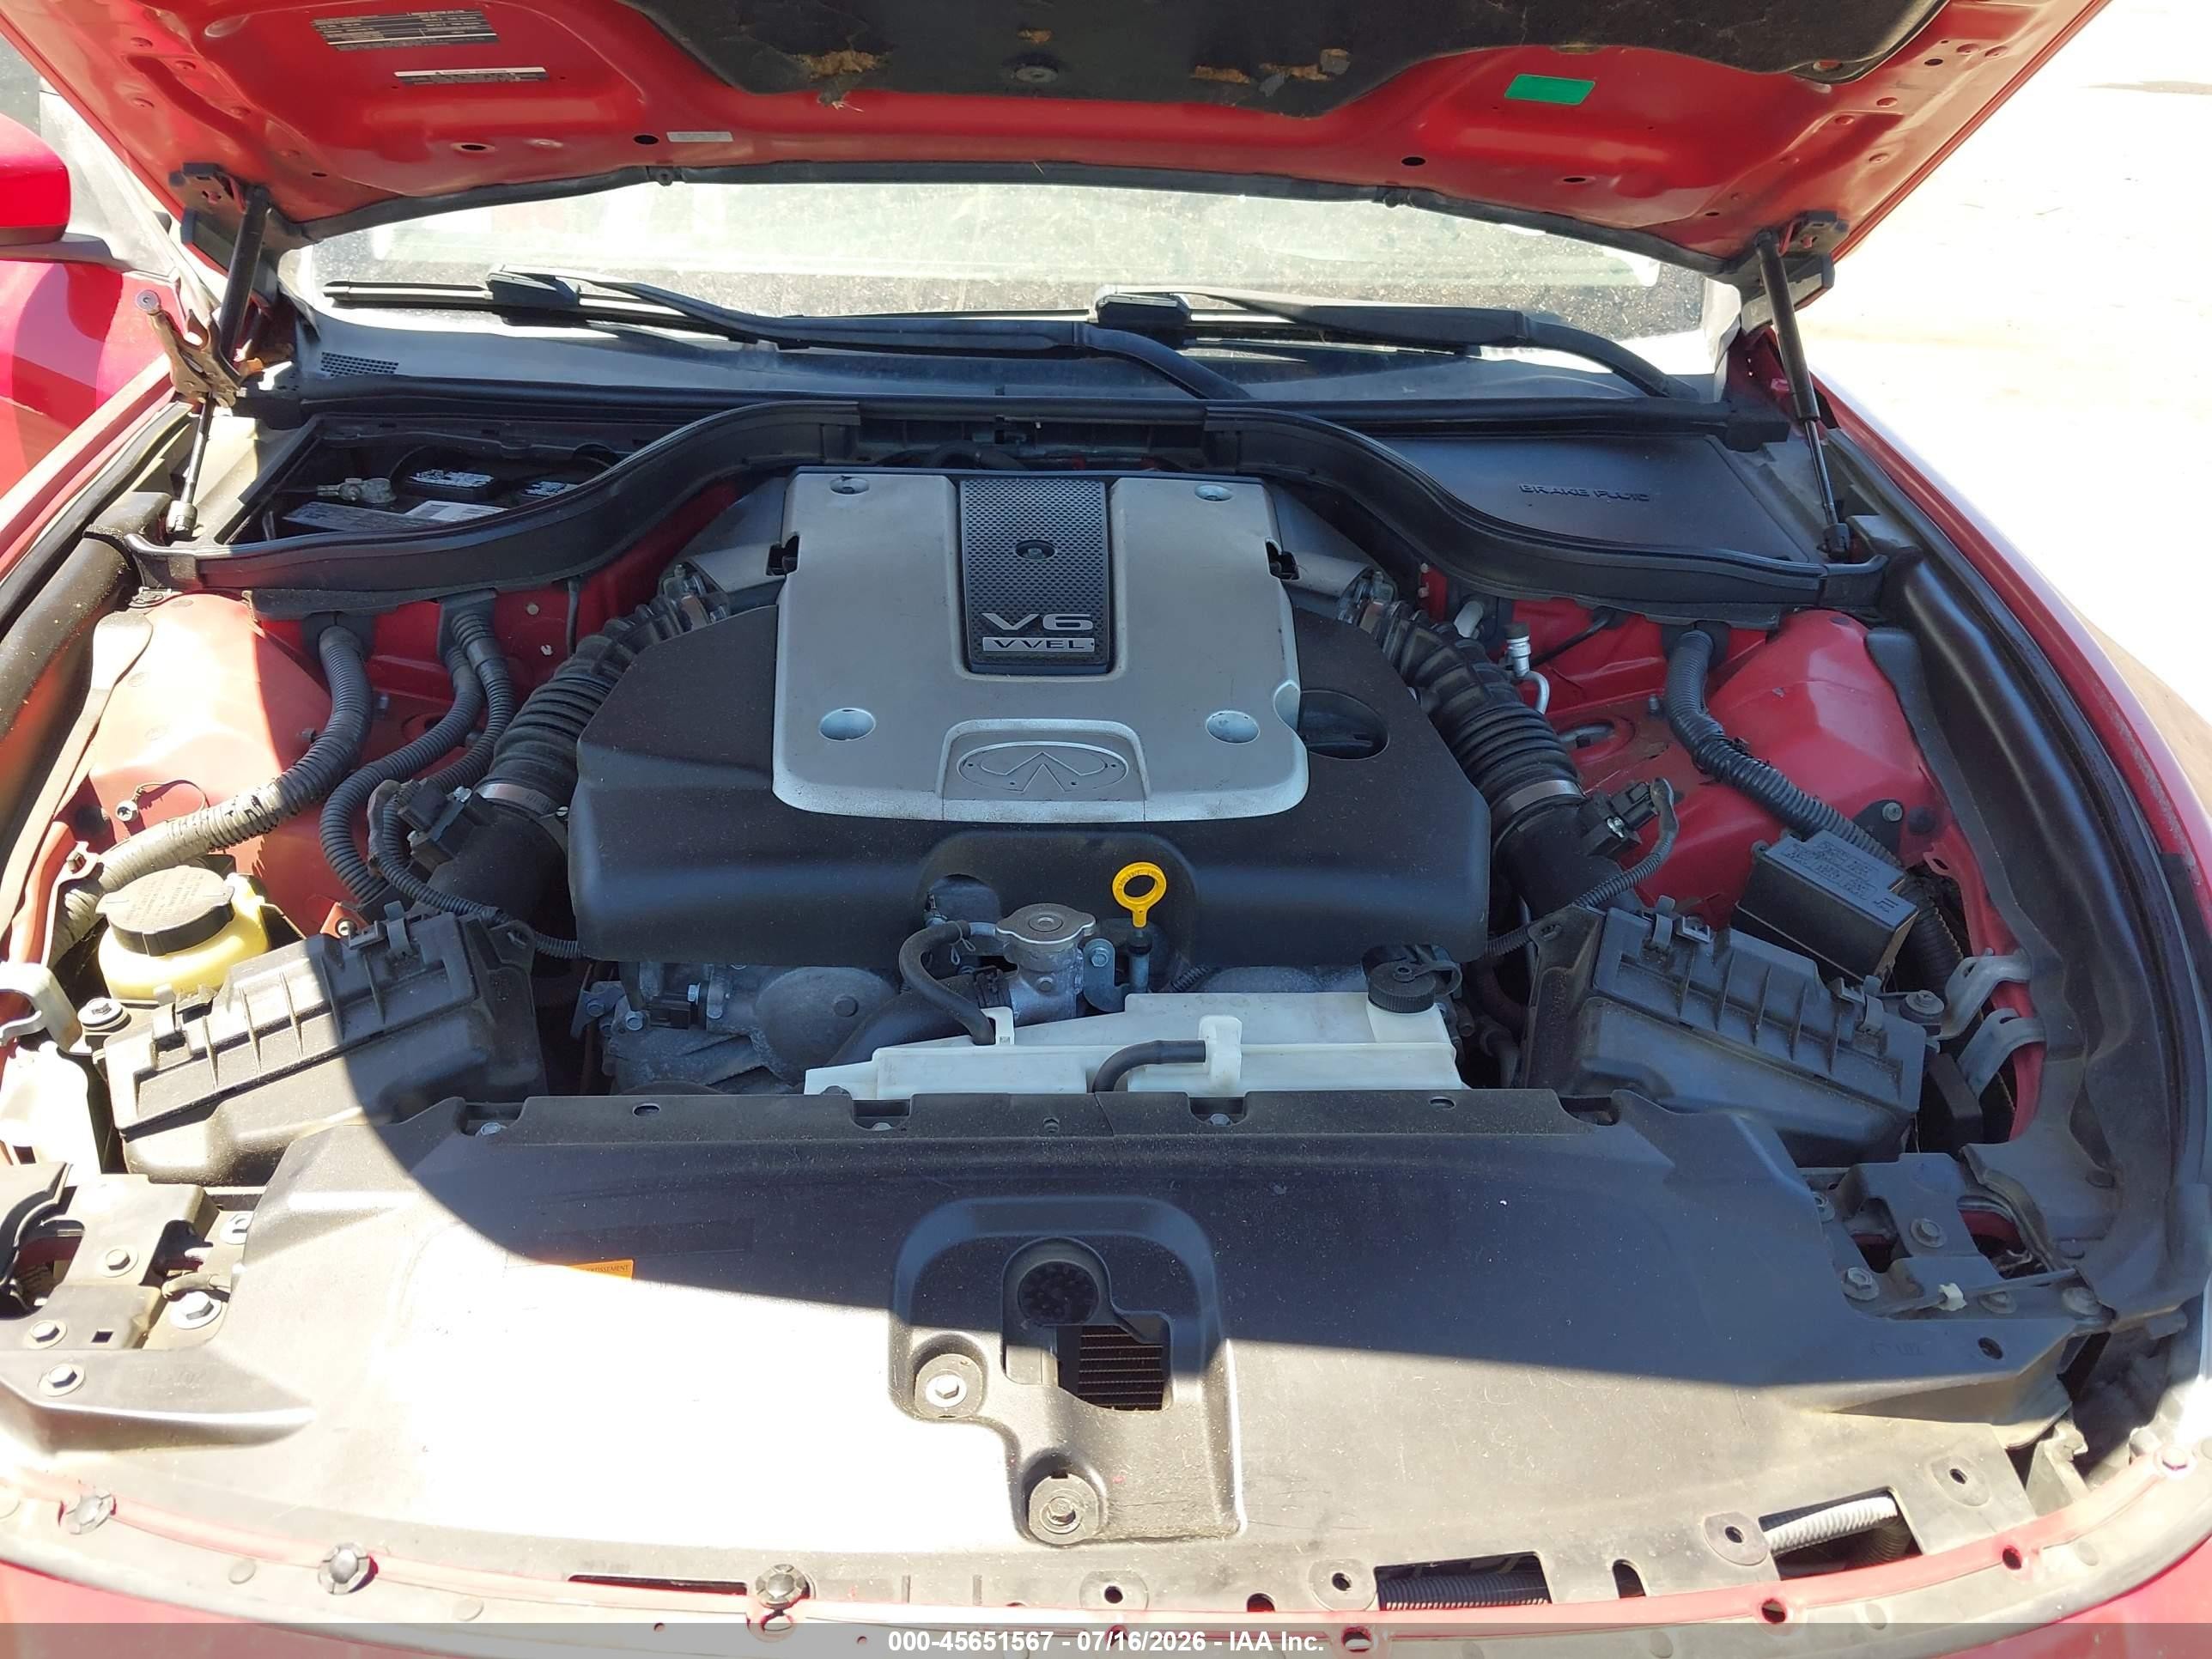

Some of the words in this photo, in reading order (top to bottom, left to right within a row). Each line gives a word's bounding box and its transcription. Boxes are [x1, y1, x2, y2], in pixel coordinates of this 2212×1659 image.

[1519, 484, 1590, 496] BRAKE
[981, 612, 1094, 631] V6
[993, 639, 1085, 649] VVEL
